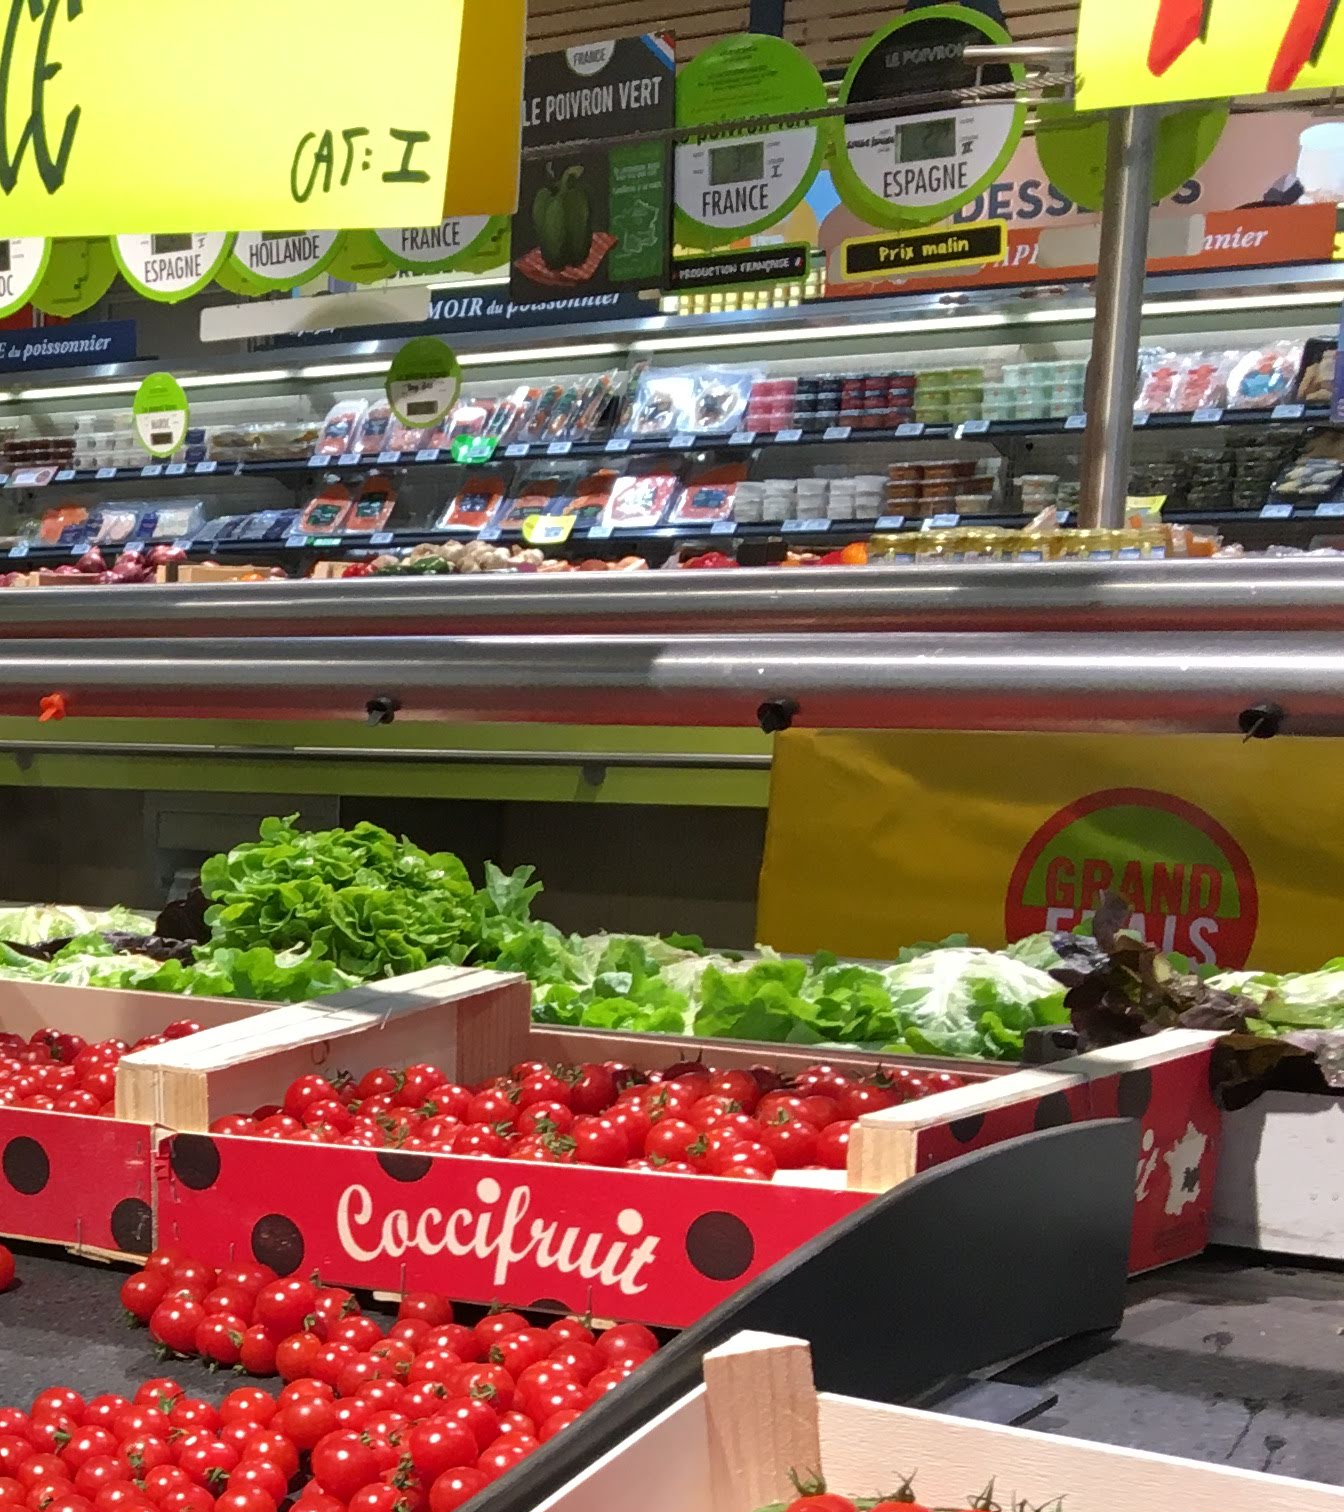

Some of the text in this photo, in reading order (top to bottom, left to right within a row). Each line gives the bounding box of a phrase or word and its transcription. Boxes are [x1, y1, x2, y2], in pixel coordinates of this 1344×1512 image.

[522, 97, 541, 127] LE
[545, 85, 613, 123] POIVRON
[618, 76, 663, 110] VERT
[291, 127, 373, 204] CAT:
[883, 161, 968, 198] ESPAGNE
[702, 183, 769, 217] FRANCE
[249, 235, 321, 268] HOLLANDE
[401, 221, 461, 252] FRANCE
[879, 237, 969, 262] Prix malin
[144, 254, 202, 283] ESPAGNE
[679, 263, 737, 280] PRODUCTION
[486, 300, 503, 316] du
[8, 345, 21, 358] du
[23, 335, 112, 361] poissonnier
[1044, 856, 1223, 918] GRAND
[336, 1177, 661, 1295] Coccifruit
